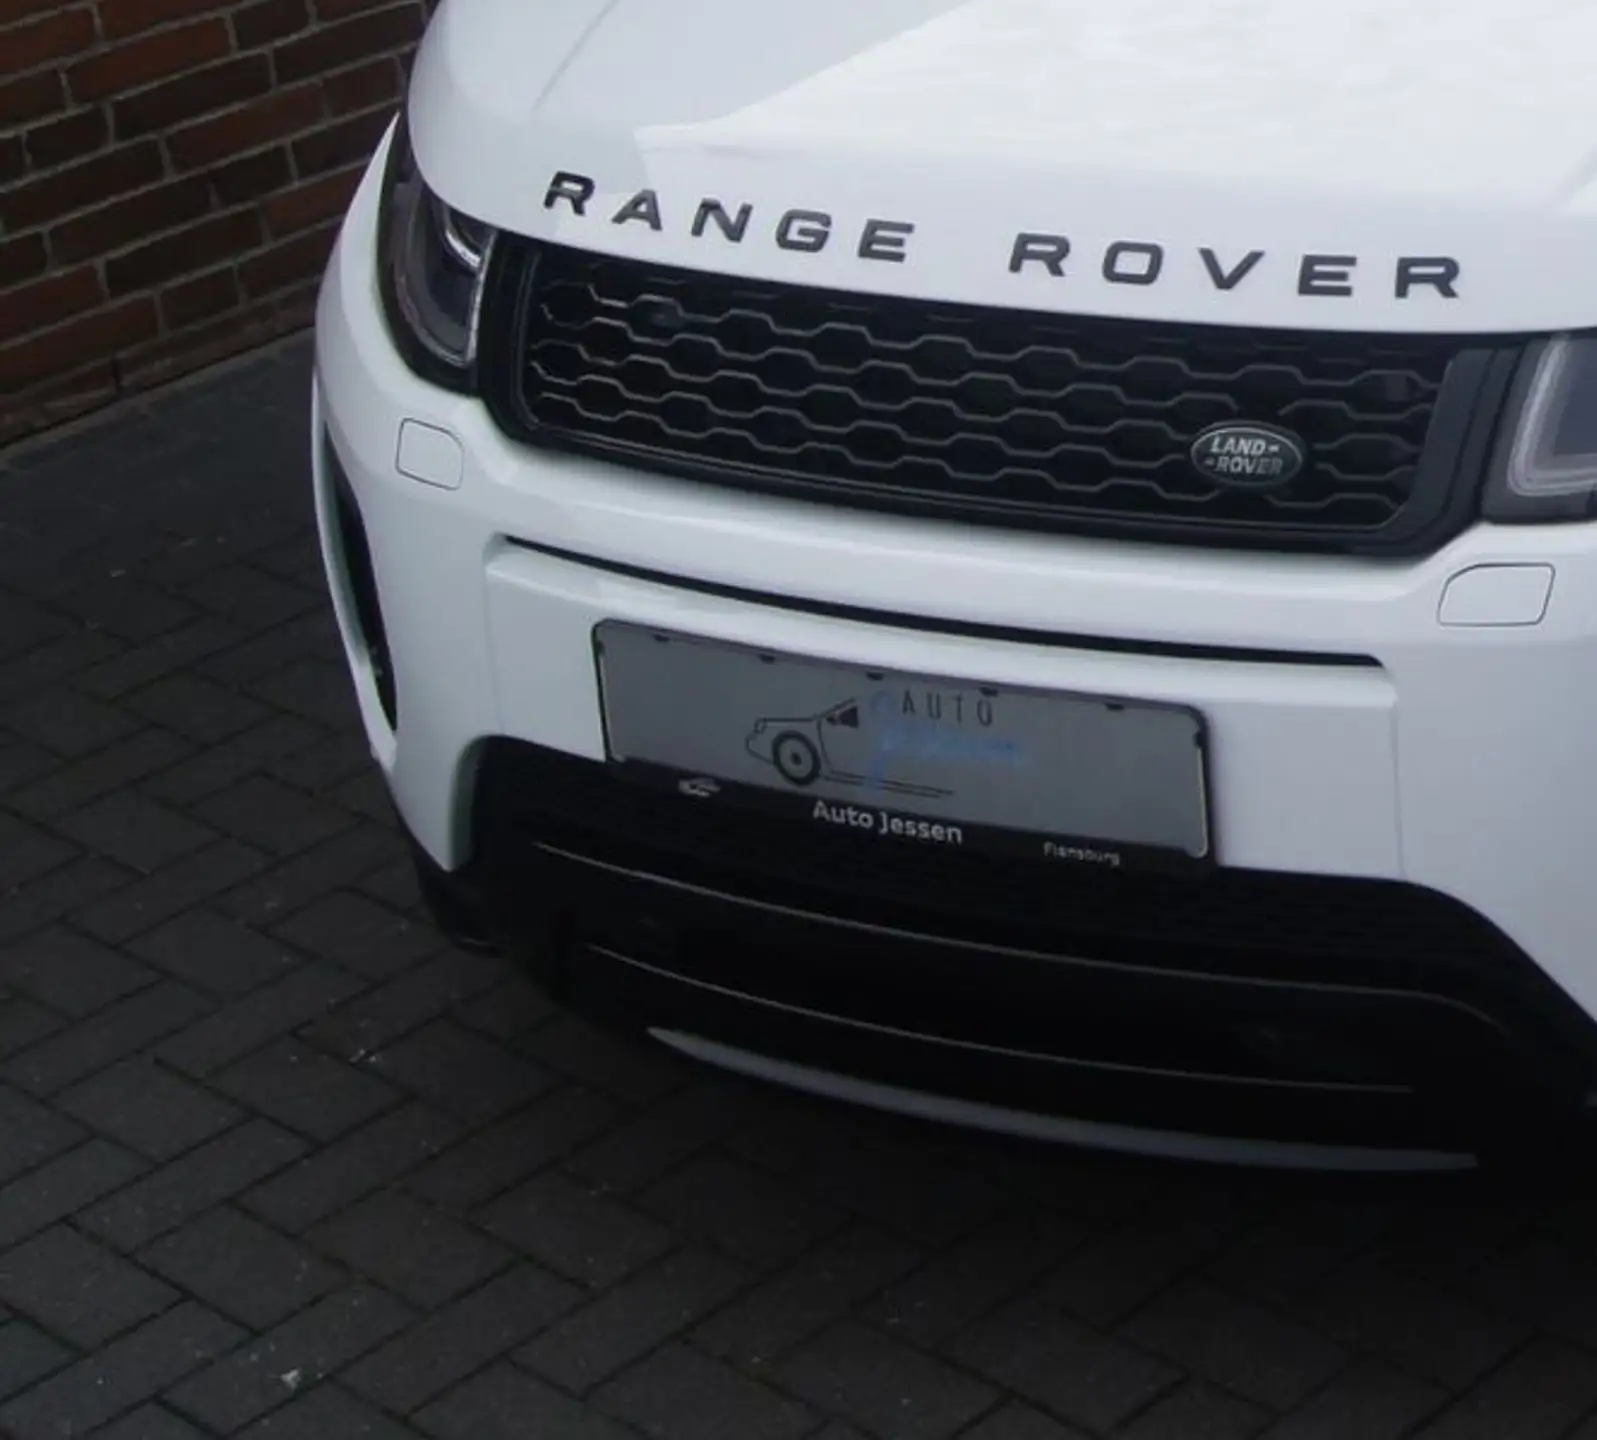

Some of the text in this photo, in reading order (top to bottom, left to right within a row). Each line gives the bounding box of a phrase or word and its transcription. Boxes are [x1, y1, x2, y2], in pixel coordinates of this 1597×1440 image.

[541, 169, 1461, 300] RANGE ROVER
[901, 688, 993, 728] AUTO
[812, 799, 963, 846] Auto Jessen
